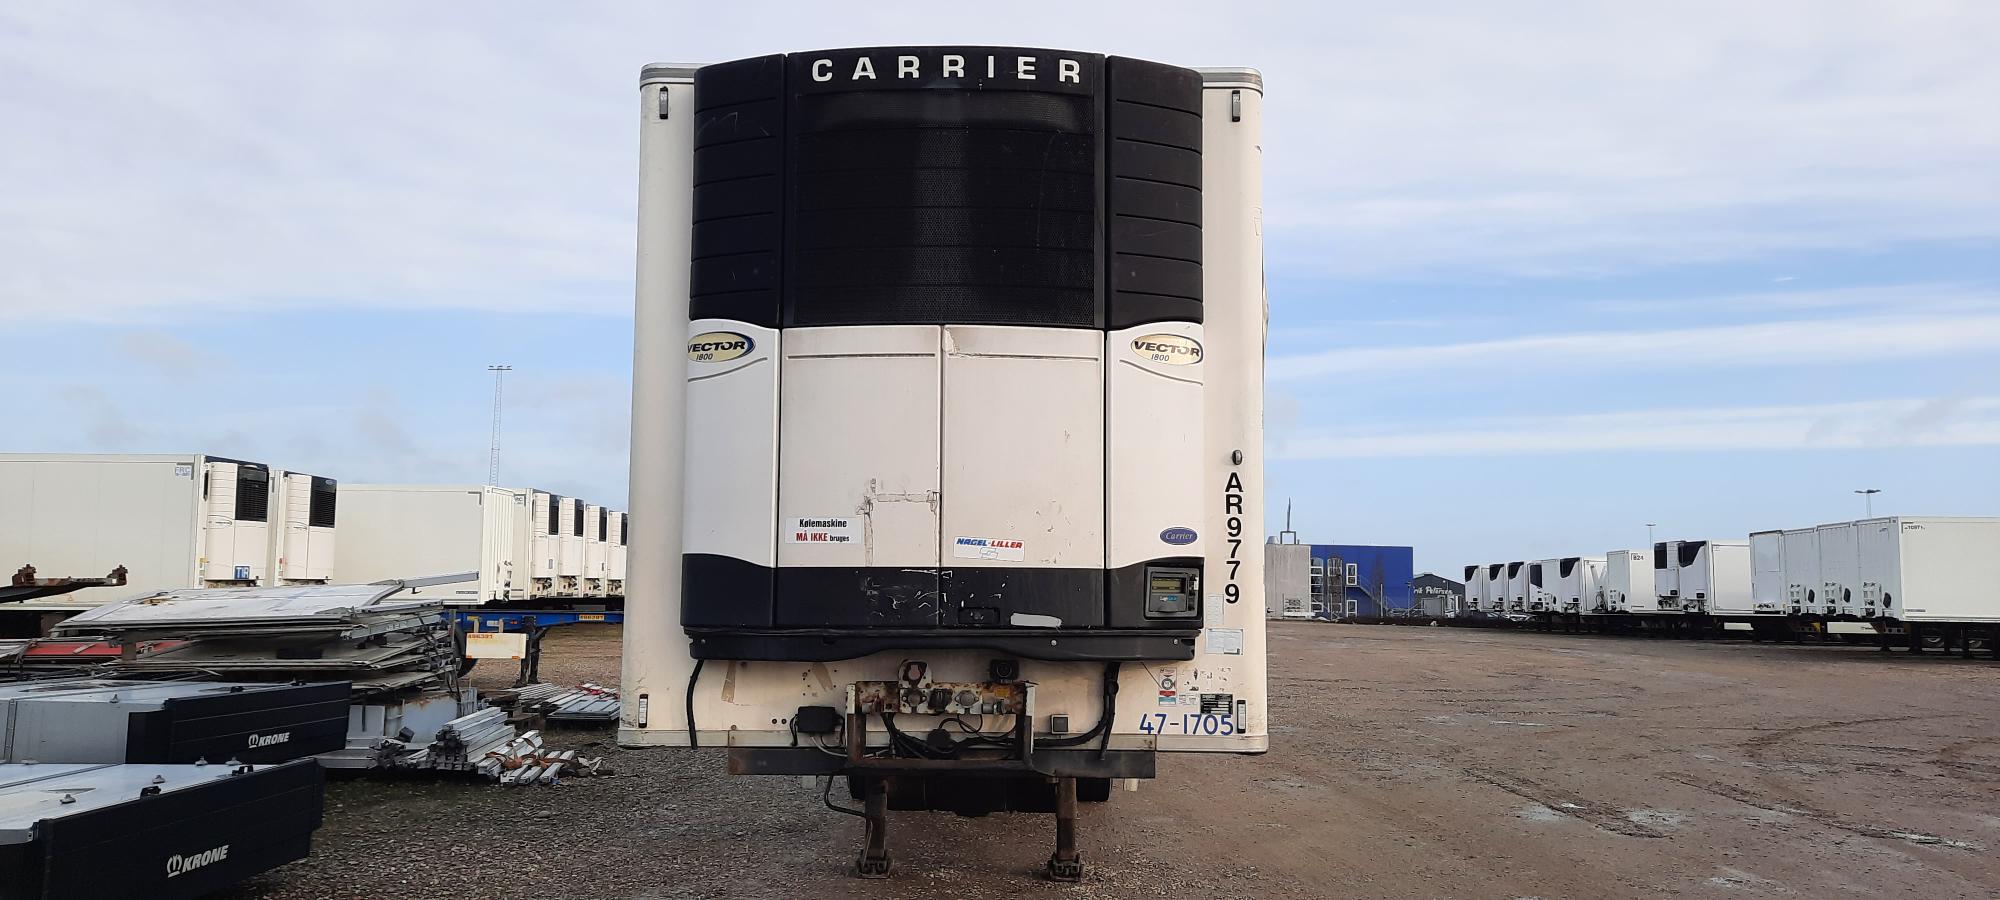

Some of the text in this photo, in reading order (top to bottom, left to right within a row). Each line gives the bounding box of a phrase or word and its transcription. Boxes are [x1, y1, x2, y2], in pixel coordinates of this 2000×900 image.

[812, 54, 1081, 84] CARRIER
[688, 341, 745, 353] VECTOR
[1134, 341, 1200, 357] VECTOR
[696, 353, 713, 361] 1800
[1151, 353, 1170, 361] 1800
[800, 519, 847, 528] Kølemaskine
[796, 530, 850, 542] MÅ IKKE bruges
[1165, 532, 1193, 540] Carrier
[1225, 472, 1243, 604] AR9779
[956, 538, 1023, 549] NAGEL-LILLER
[236, 567, 250, 579] TIR
[1139, 713, 1234, 736] 47-1705
[258, 731, 290, 747] KRONE
[182, 844, 230, 873] KRONE
